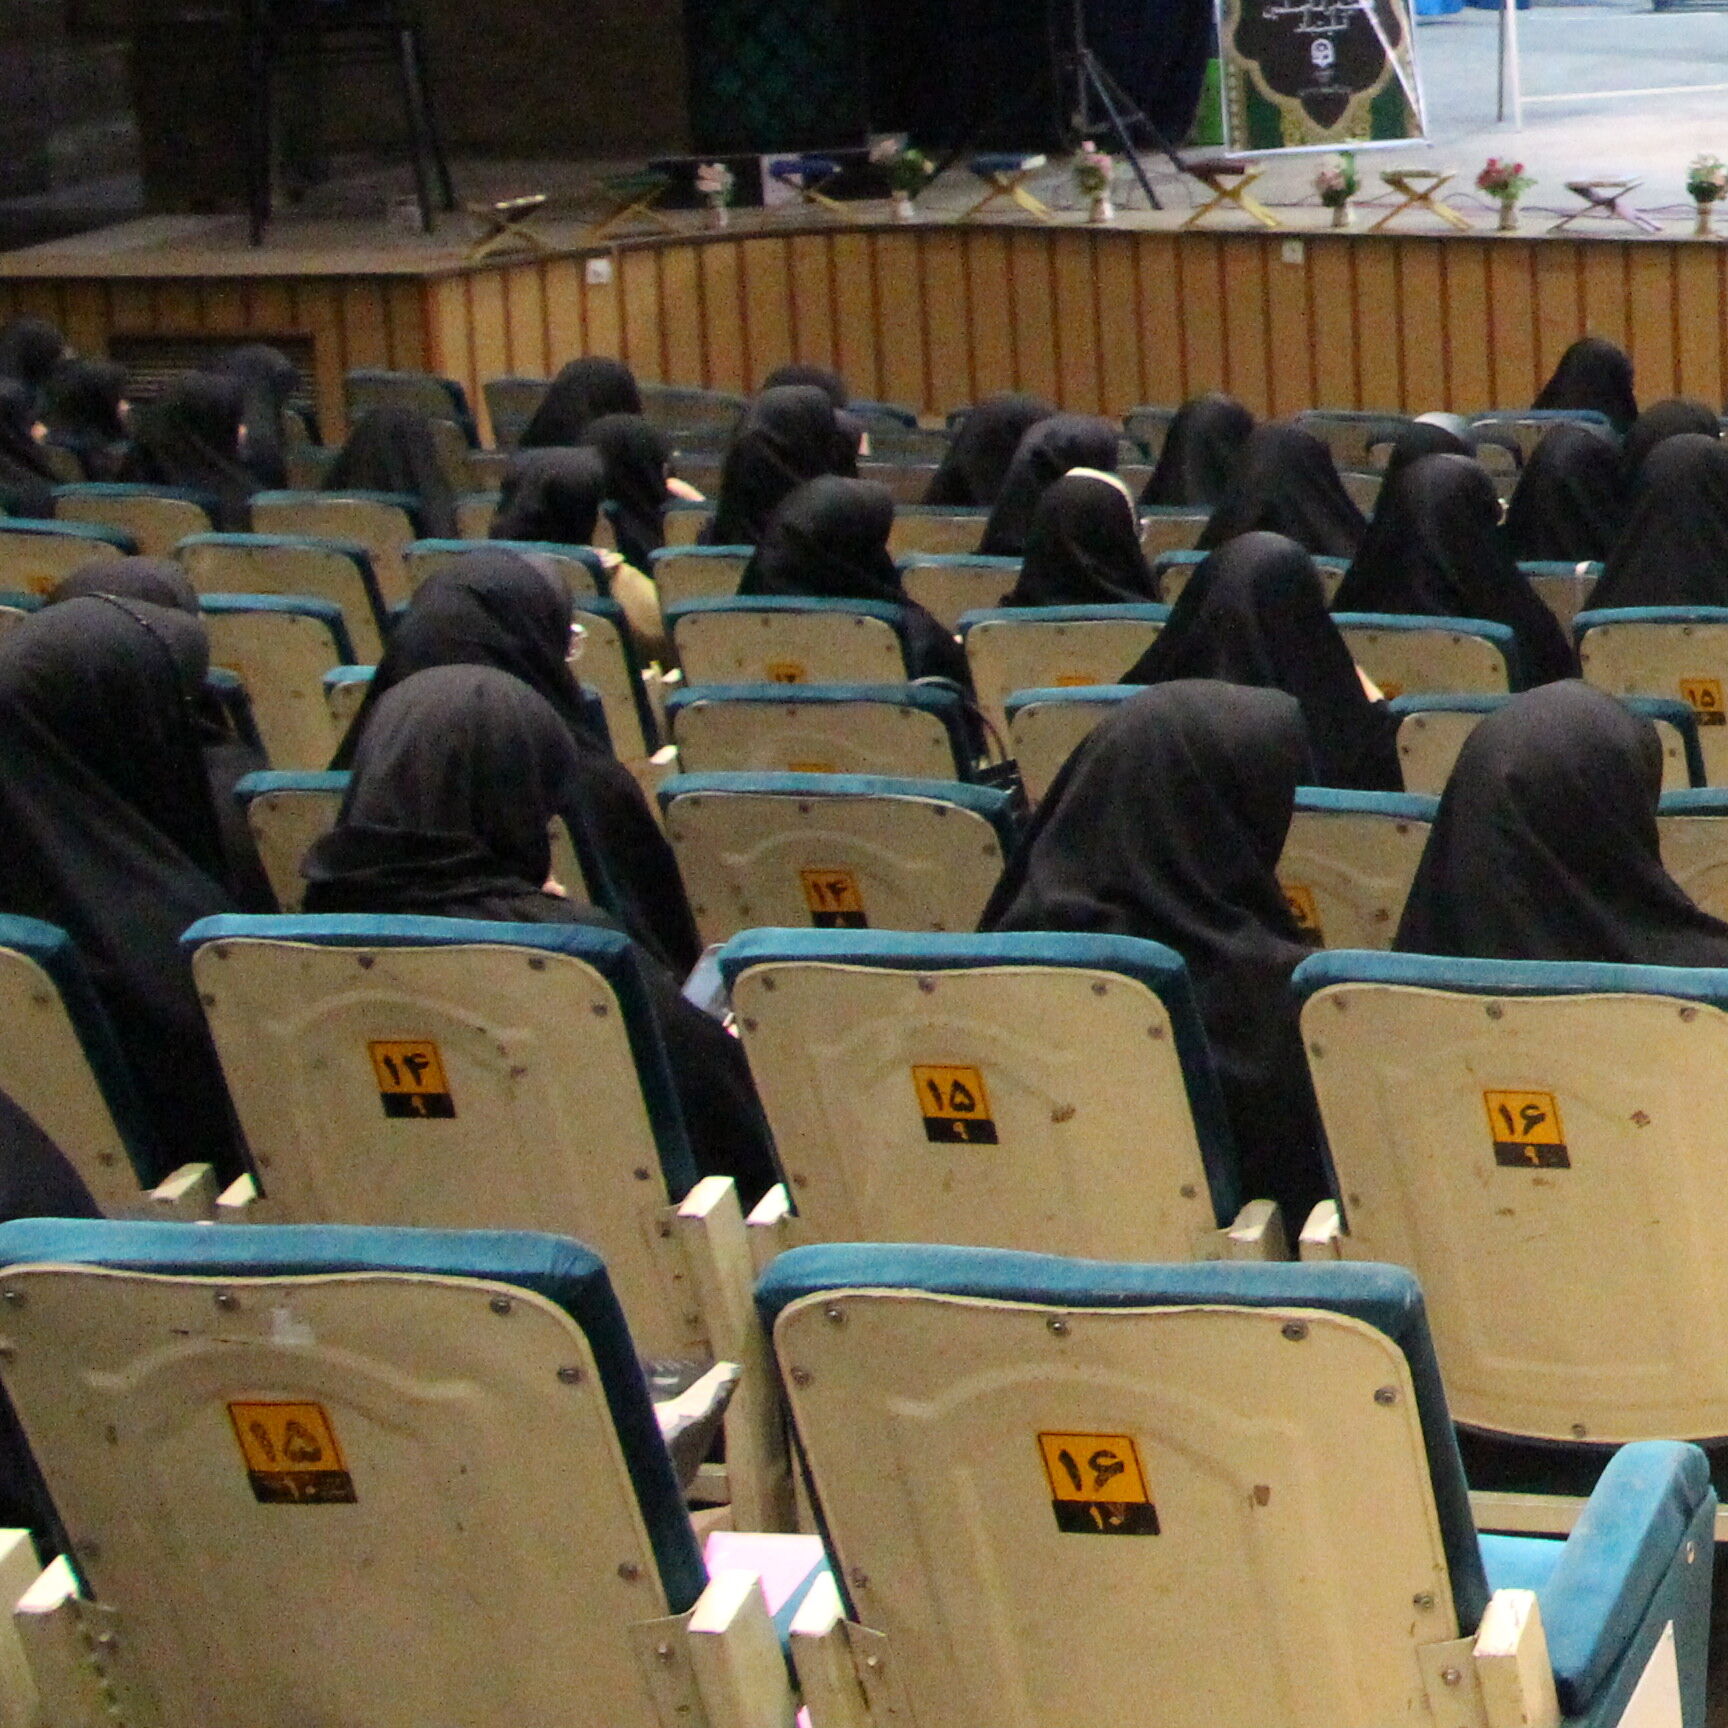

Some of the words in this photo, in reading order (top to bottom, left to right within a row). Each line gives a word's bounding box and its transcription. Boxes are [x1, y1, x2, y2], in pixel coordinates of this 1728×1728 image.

[383, 1052, 430, 1087] ۱۴
[926, 1077, 976, 1112] ۱۵
[952, 1120, 970, 1141] ۹
[1498, 1103, 1547, 1136] ۱۶
[1522, 1144, 1541, 1166] ۹
[249, 1420, 323, 1464] ۱۵
[1057, 1448, 1125, 1494] ۱۶
